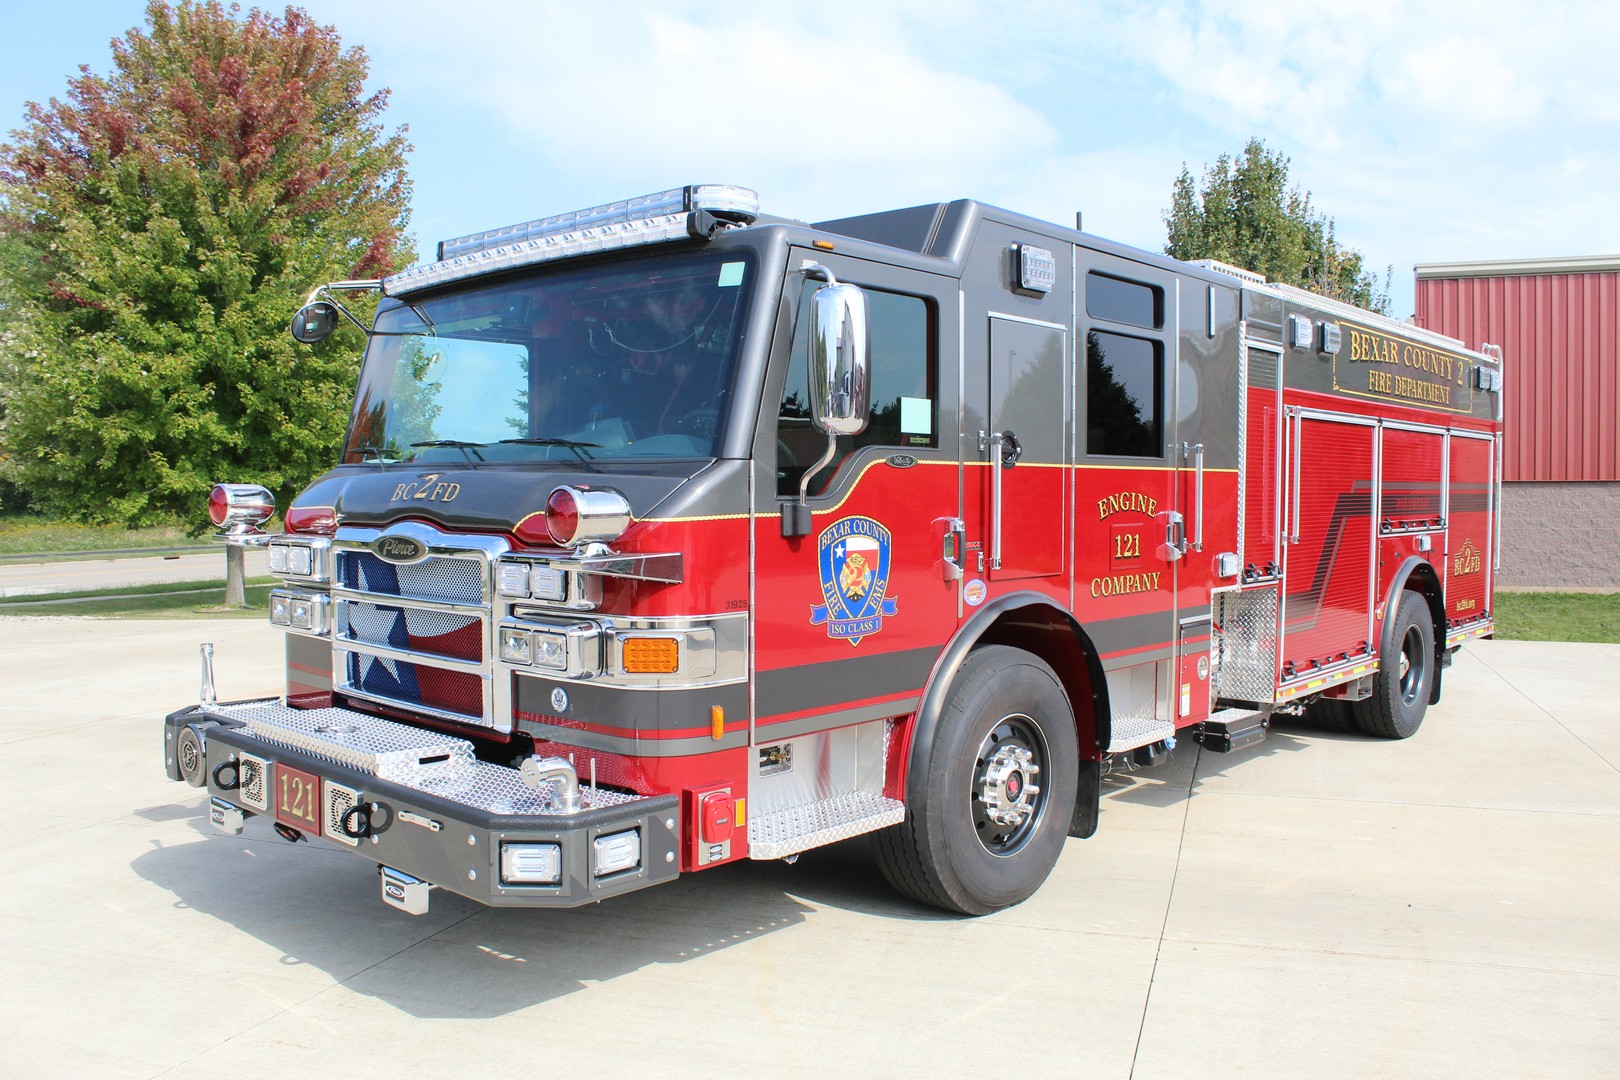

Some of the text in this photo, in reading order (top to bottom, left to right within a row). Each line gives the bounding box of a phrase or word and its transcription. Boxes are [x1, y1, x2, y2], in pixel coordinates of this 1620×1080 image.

[1350, 330, 1464, 386] BEXAR COUNTY 2
[1368, 369, 1450, 405] FIRE DEPARTMENT
[1097, 491, 1158, 521] ENGINE
[382, 538, 415, 556] Pierce
[821, 519, 889, 550] BEXAR COUNTY
[1115, 533, 1141, 559] 121
[849, 566, 864, 588] 2
[1091, 571, 1161, 598] COMPANY
[725, 599, 748, 610] 31925
[824, 582, 842, 616] FIRE
[869, 578, 886, 610] EMS
[831, 619, 880, 634] ISO CLASS 1
[280, 773, 315, 823] 121
